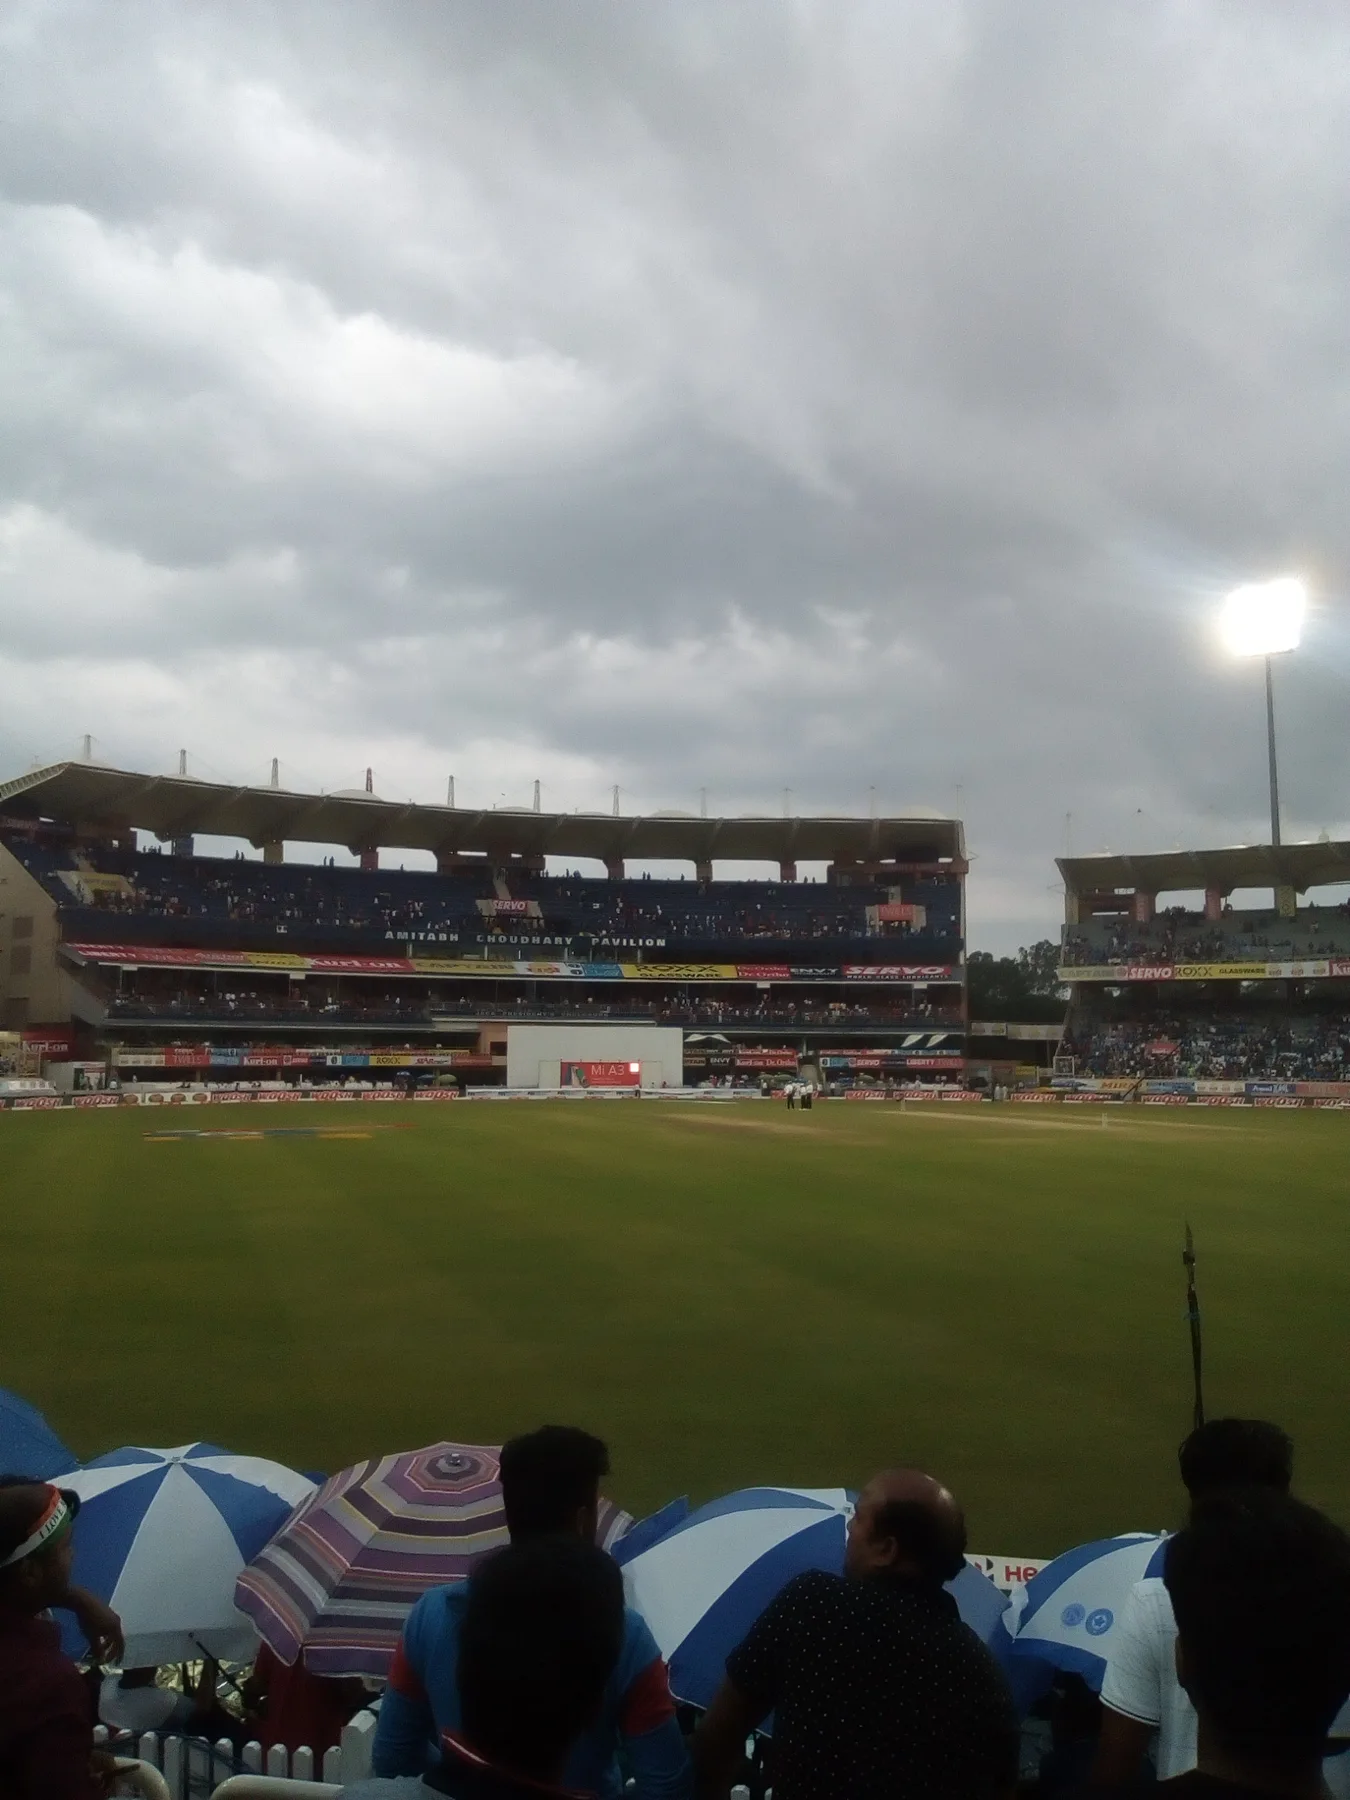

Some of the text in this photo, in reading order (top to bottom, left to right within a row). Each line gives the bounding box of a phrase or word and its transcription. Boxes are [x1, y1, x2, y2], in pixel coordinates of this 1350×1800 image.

[493, 900, 526, 911] SERVO
[384, 930, 667, 948] AMITABH CHOUDHARY PAVILION
[635, 964, 719, 973] ROXX
[846, 966, 945, 975] SERVO
[1129, 967, 1172, 979] SERVO
[1175, 966, 1213, 978] ROXX
[243, 1056, 278, 1066] Kurl-on
[906, 1058, 935, 1066] LIBERTY
[591, 1064, 625, 1076] Mi A3
[45, 1508, 65, 1534] LOVE
[1004, 1564, 1037, 1583] He
